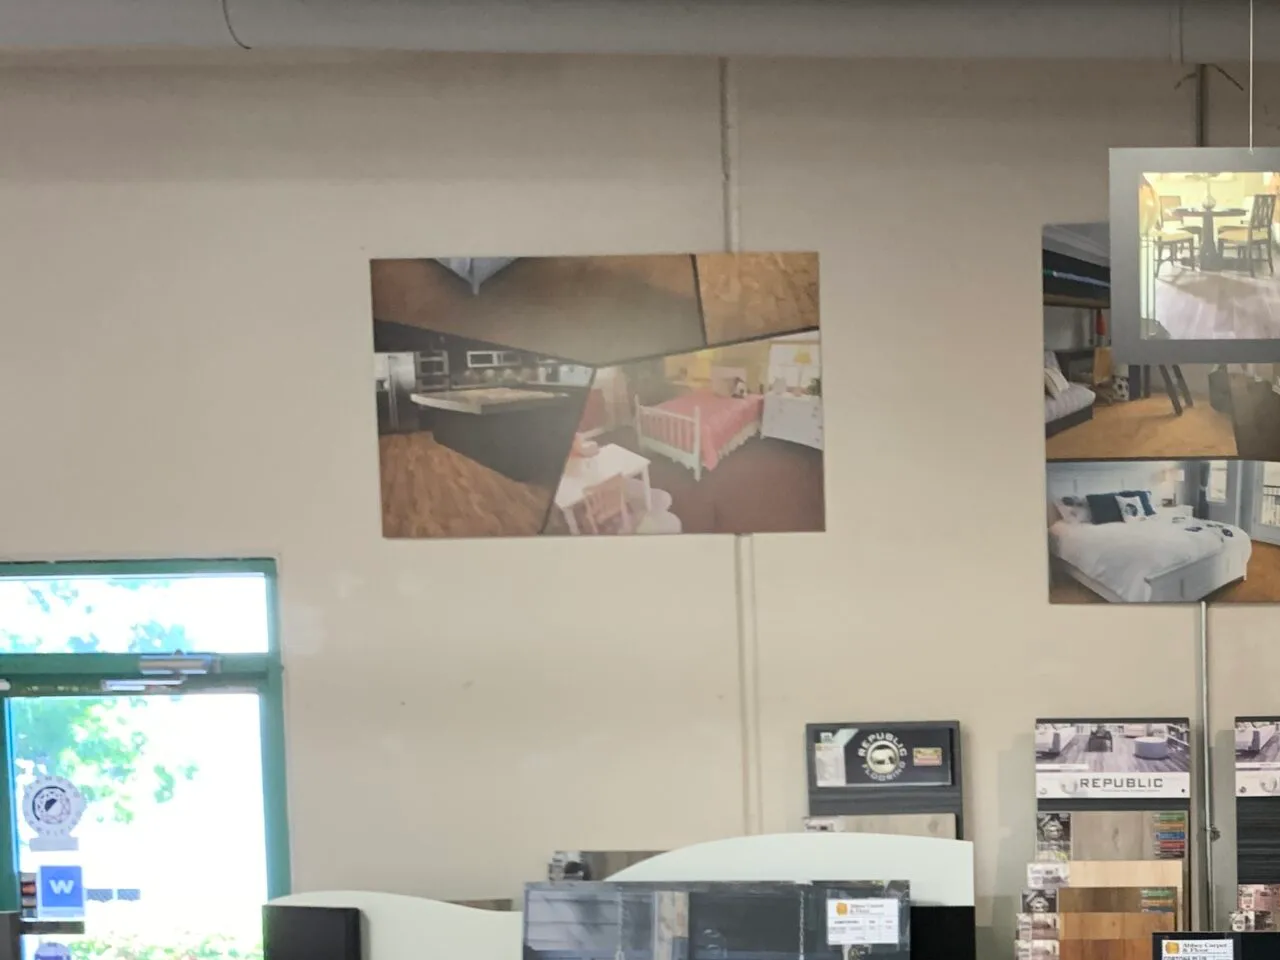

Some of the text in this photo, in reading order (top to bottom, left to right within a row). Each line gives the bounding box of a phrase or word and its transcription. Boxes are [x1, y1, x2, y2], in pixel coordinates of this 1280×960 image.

[857, 731, 908, 757] REPUBLIC
[861, 760, 907, 782] FLOORING
[1080, 777, 1164, 788] REPUBLIC
